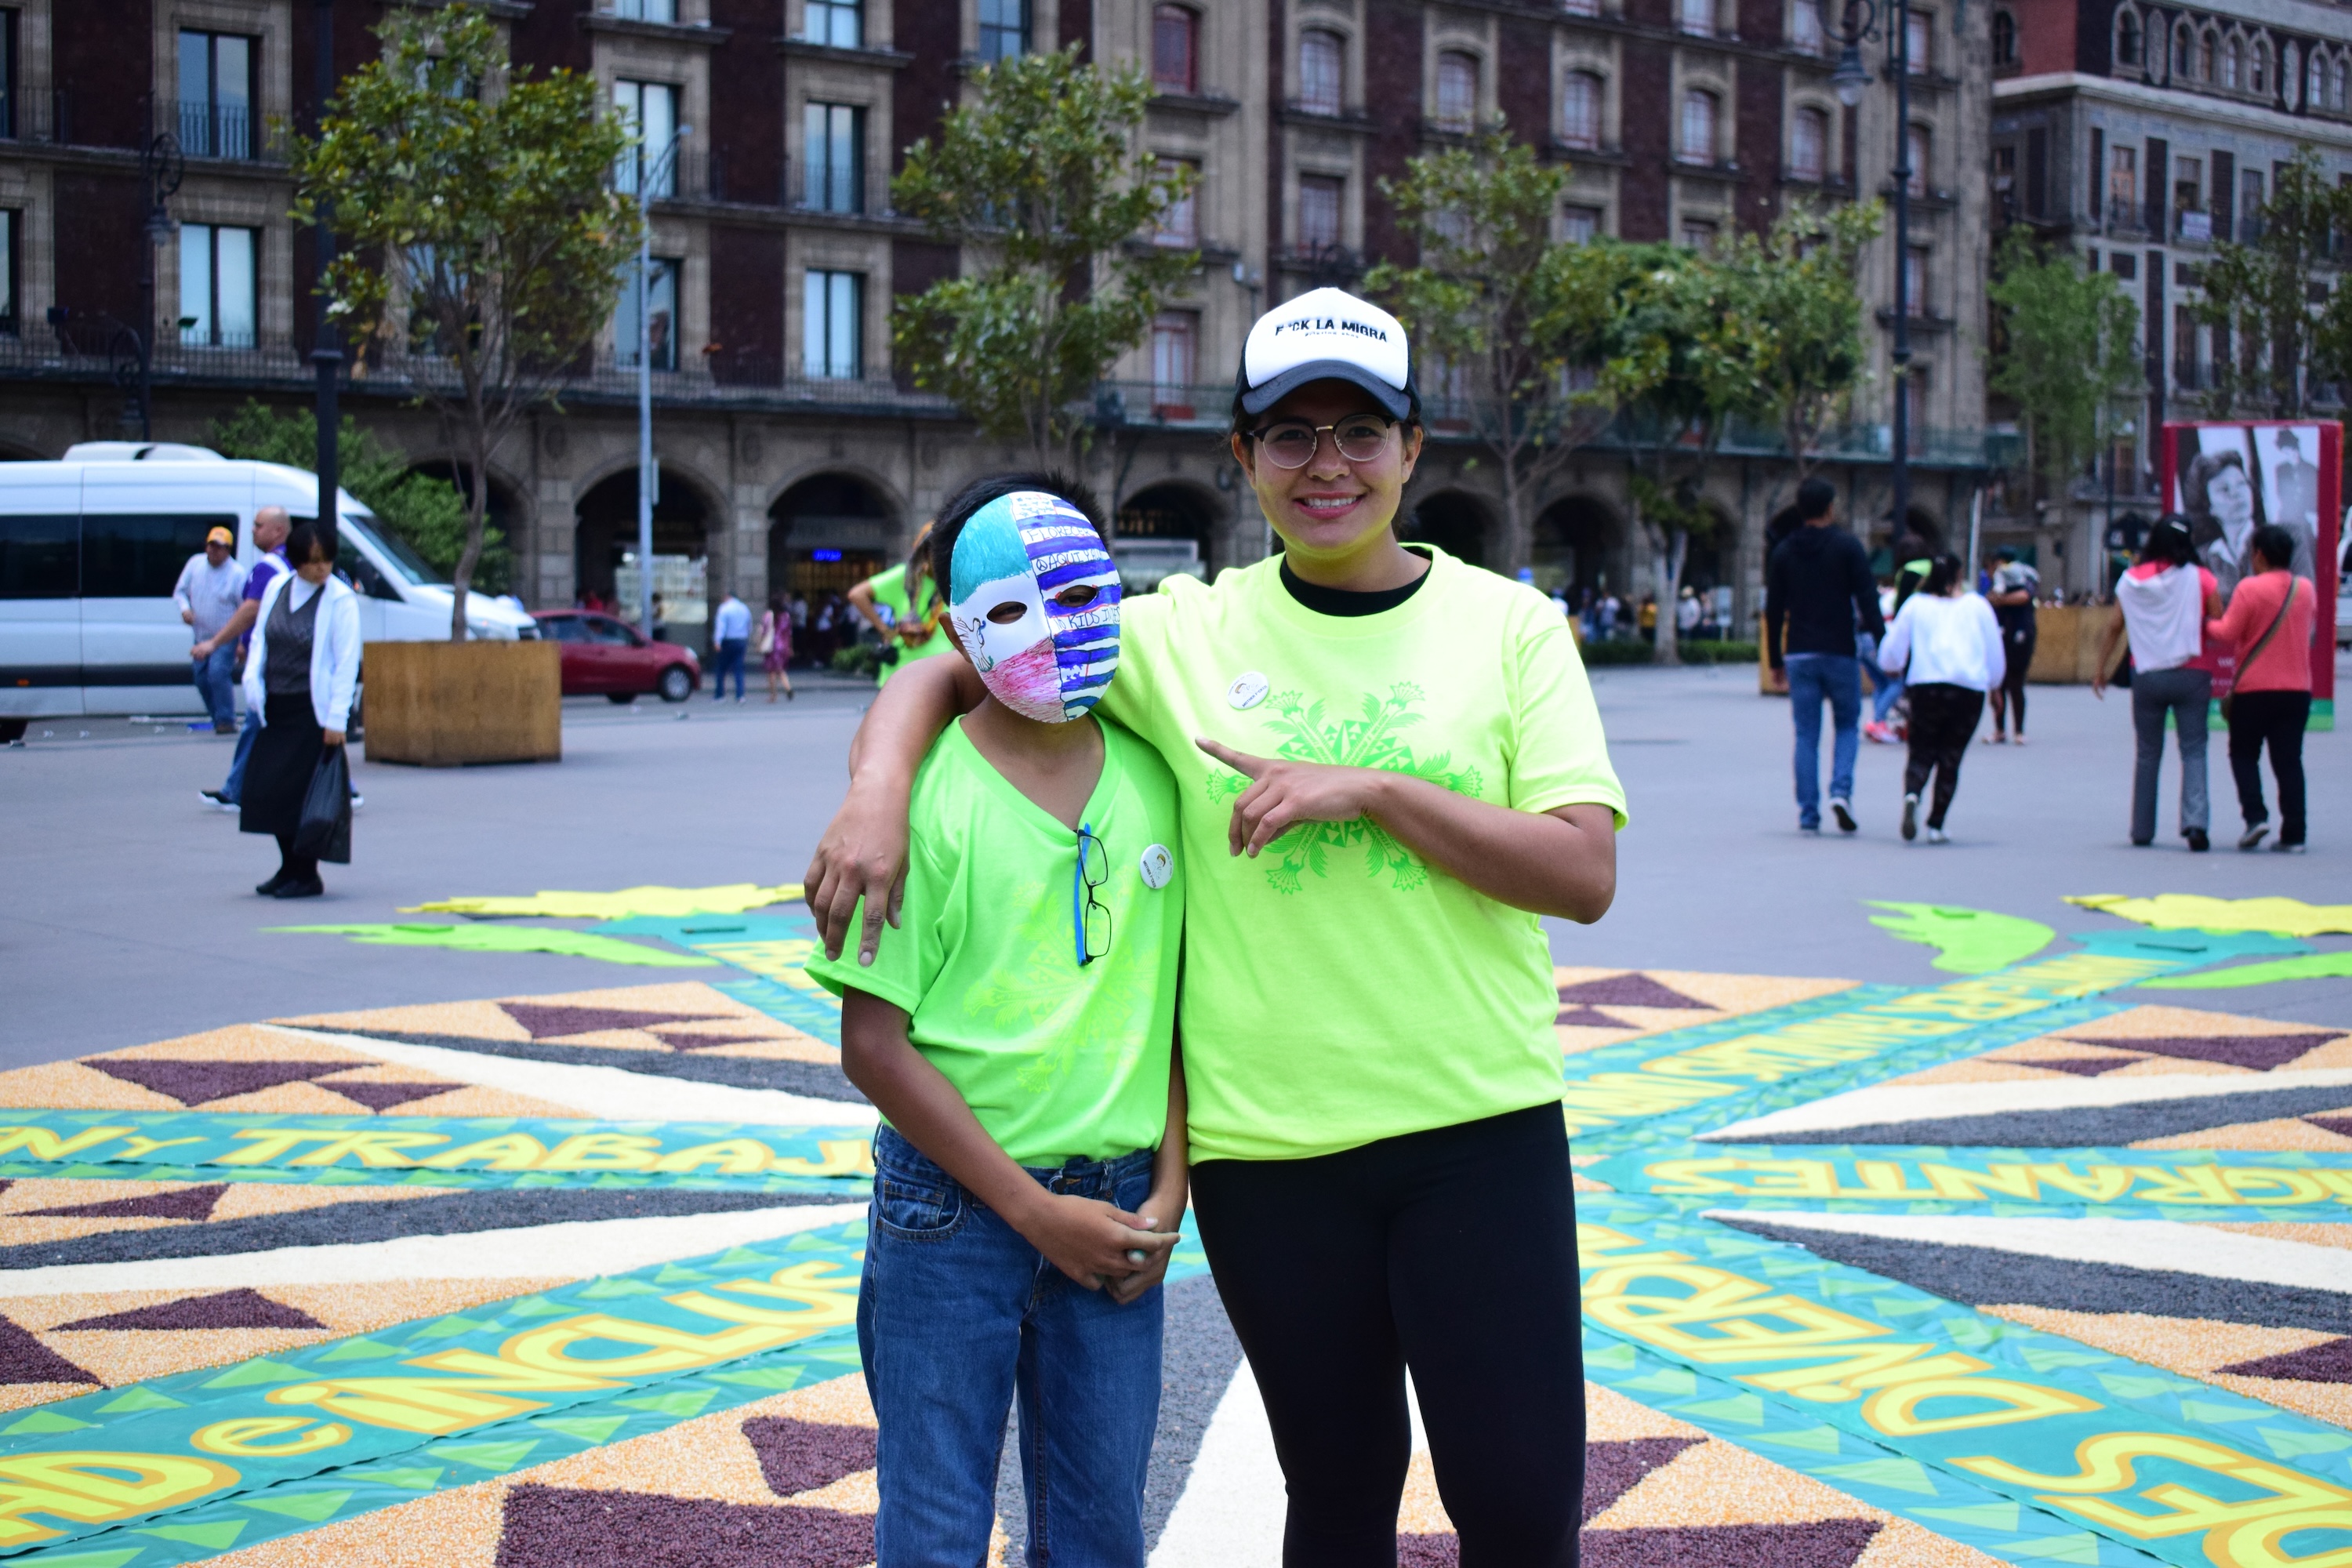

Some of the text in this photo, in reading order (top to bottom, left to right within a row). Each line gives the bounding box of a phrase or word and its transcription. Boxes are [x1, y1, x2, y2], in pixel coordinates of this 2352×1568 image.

[1316, 319, 1334, 330] LA
[1341, 321, 1387, 342] MIGRA
[1027, 526, 1091, 542] FLORECER
[1049, 551, 1083, 569] AQUI
[1068, 612, 1100, 629] KIDS
[1242, 695, 1256, 708] MOTHER
[1143, 860, 1152, 876] MOTHER
[213, 1127, 877, 1174] TRABAJ
